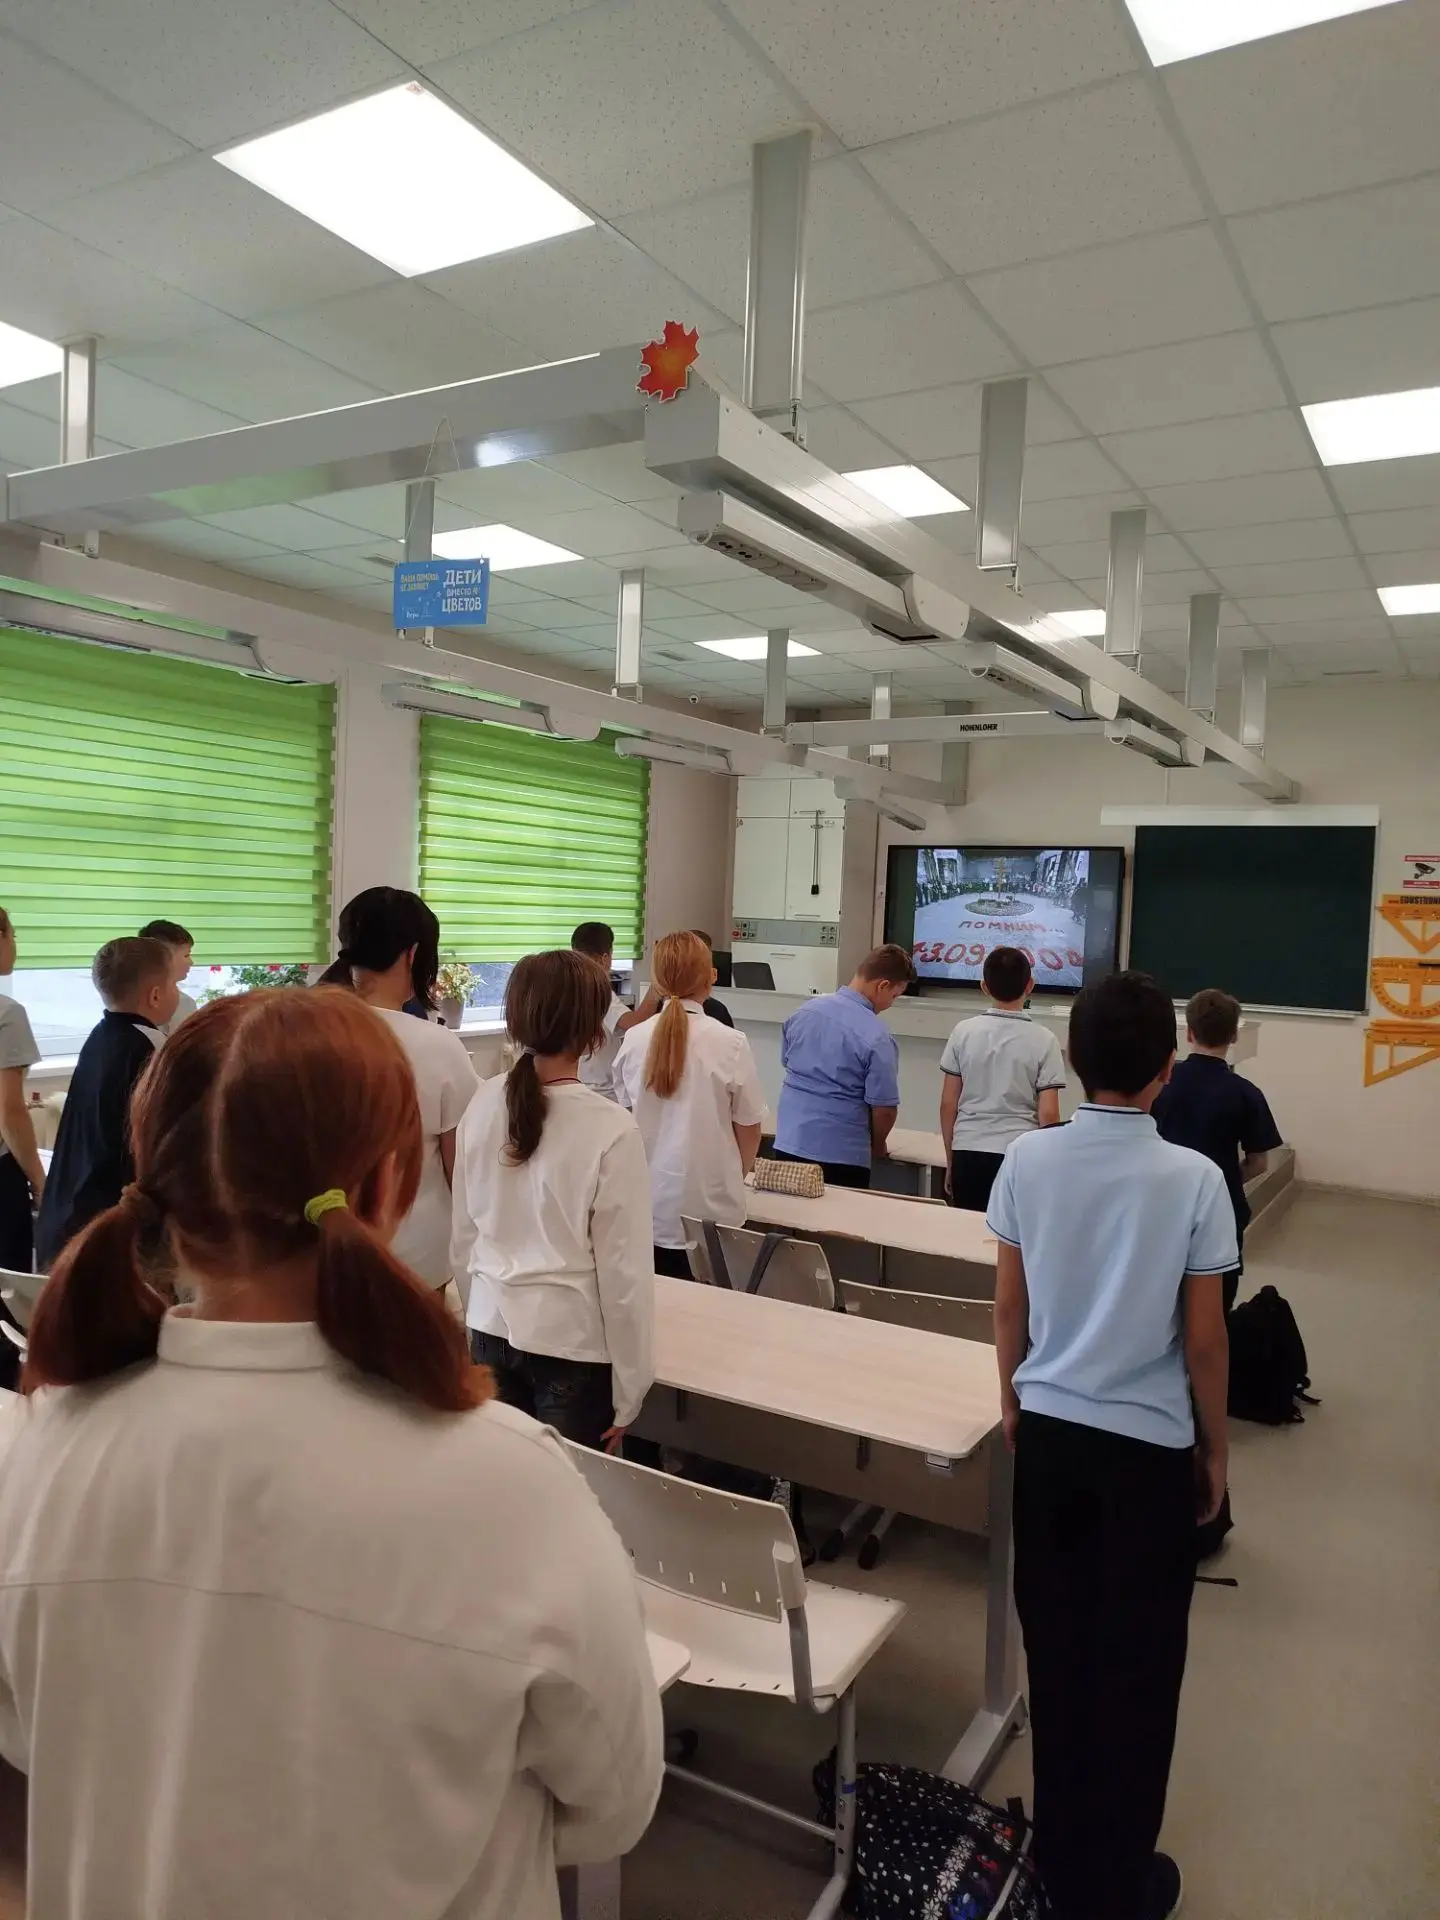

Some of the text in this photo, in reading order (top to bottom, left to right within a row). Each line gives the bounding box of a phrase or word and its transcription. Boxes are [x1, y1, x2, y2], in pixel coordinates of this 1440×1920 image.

[442, 569, 482, 588] ДЕТИ
[446, 587, 472, 597] ВМЕСТО
[442, 597, 482, 614] ЦВЕТОВ
